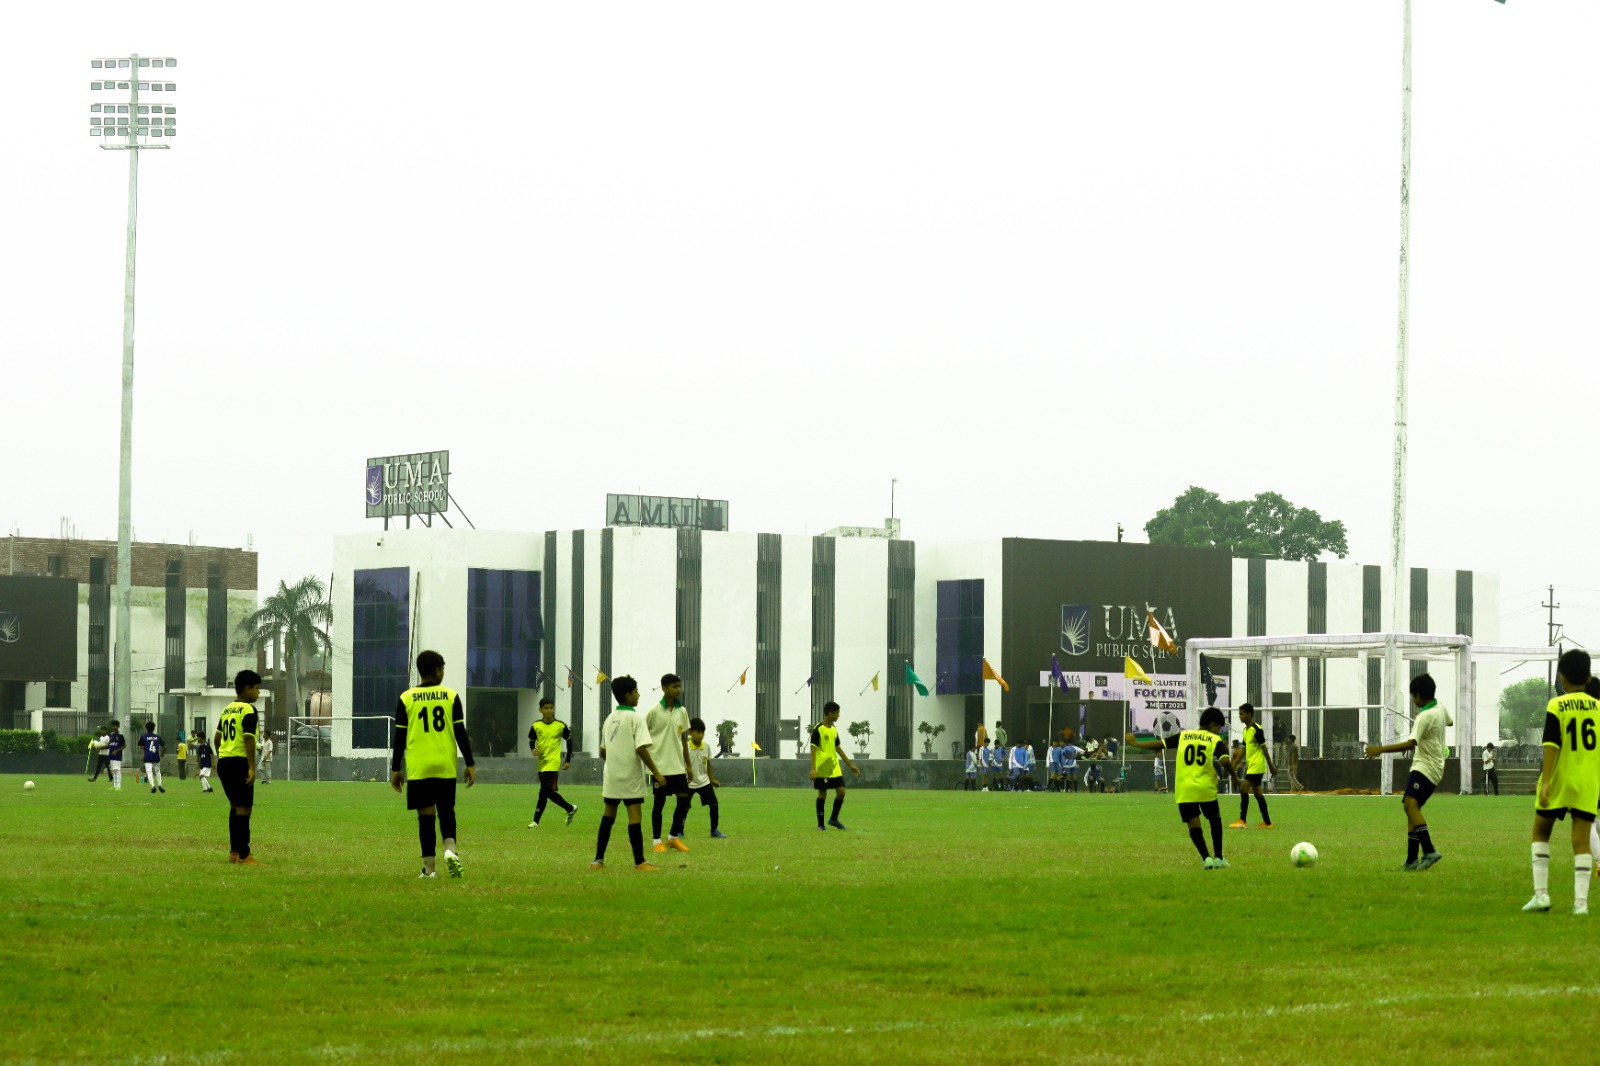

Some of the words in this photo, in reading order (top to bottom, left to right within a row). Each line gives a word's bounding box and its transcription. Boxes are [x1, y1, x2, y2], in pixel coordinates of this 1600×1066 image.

[384, 458, 445, 488] UMA
[383, 492, 411, 505] PUBLIC
[414, 489, 444, 503] SCHOOL
[1096, 643, 1139, 657] PUBLIC
[412, 691, 448, 702] SHIVALIK
[1558, 699, 1598, 712] SHIVALIK
[418, 705, 445, 733] 18
[223, 718, 236, 742] 06
[1183, 733, 1212, 743] SHIVALIK
[1566, 717, 1596, 751] 16
[149, 741, 157, 753] 4
[1184, 743, 1207, 767] 05
